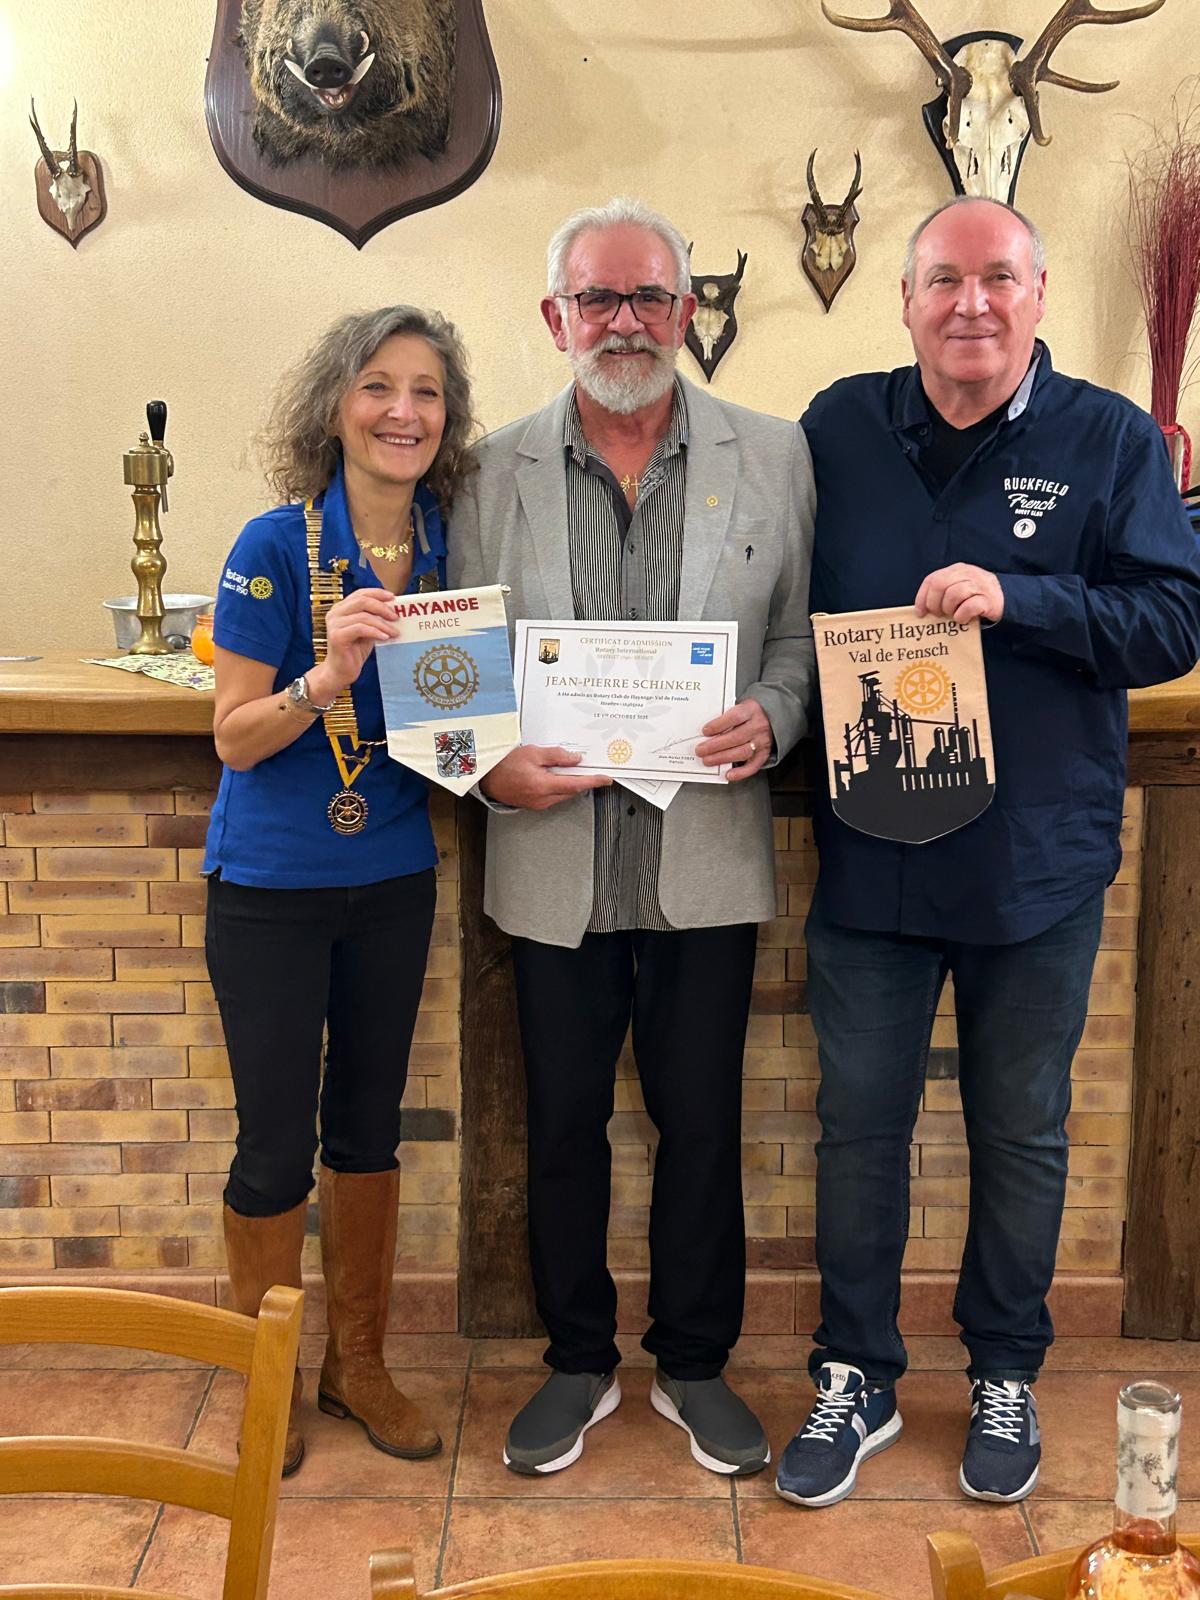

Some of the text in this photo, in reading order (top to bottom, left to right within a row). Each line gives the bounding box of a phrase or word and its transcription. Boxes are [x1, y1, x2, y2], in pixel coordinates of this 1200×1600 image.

[1004, 477, 1070, 497] RUCKFIELD
[1008, 493, 1057, 511] French
[394, 597, 480, 618] HAYANGE
[418, 617, 461, 631] FRANCE
[823, 620, 970, 648] Rotary Hayange
[848, 642, 950, 664] Val de Fensch
[545, 676, 702, 692] JEAN-PIERRE SCHINKER
